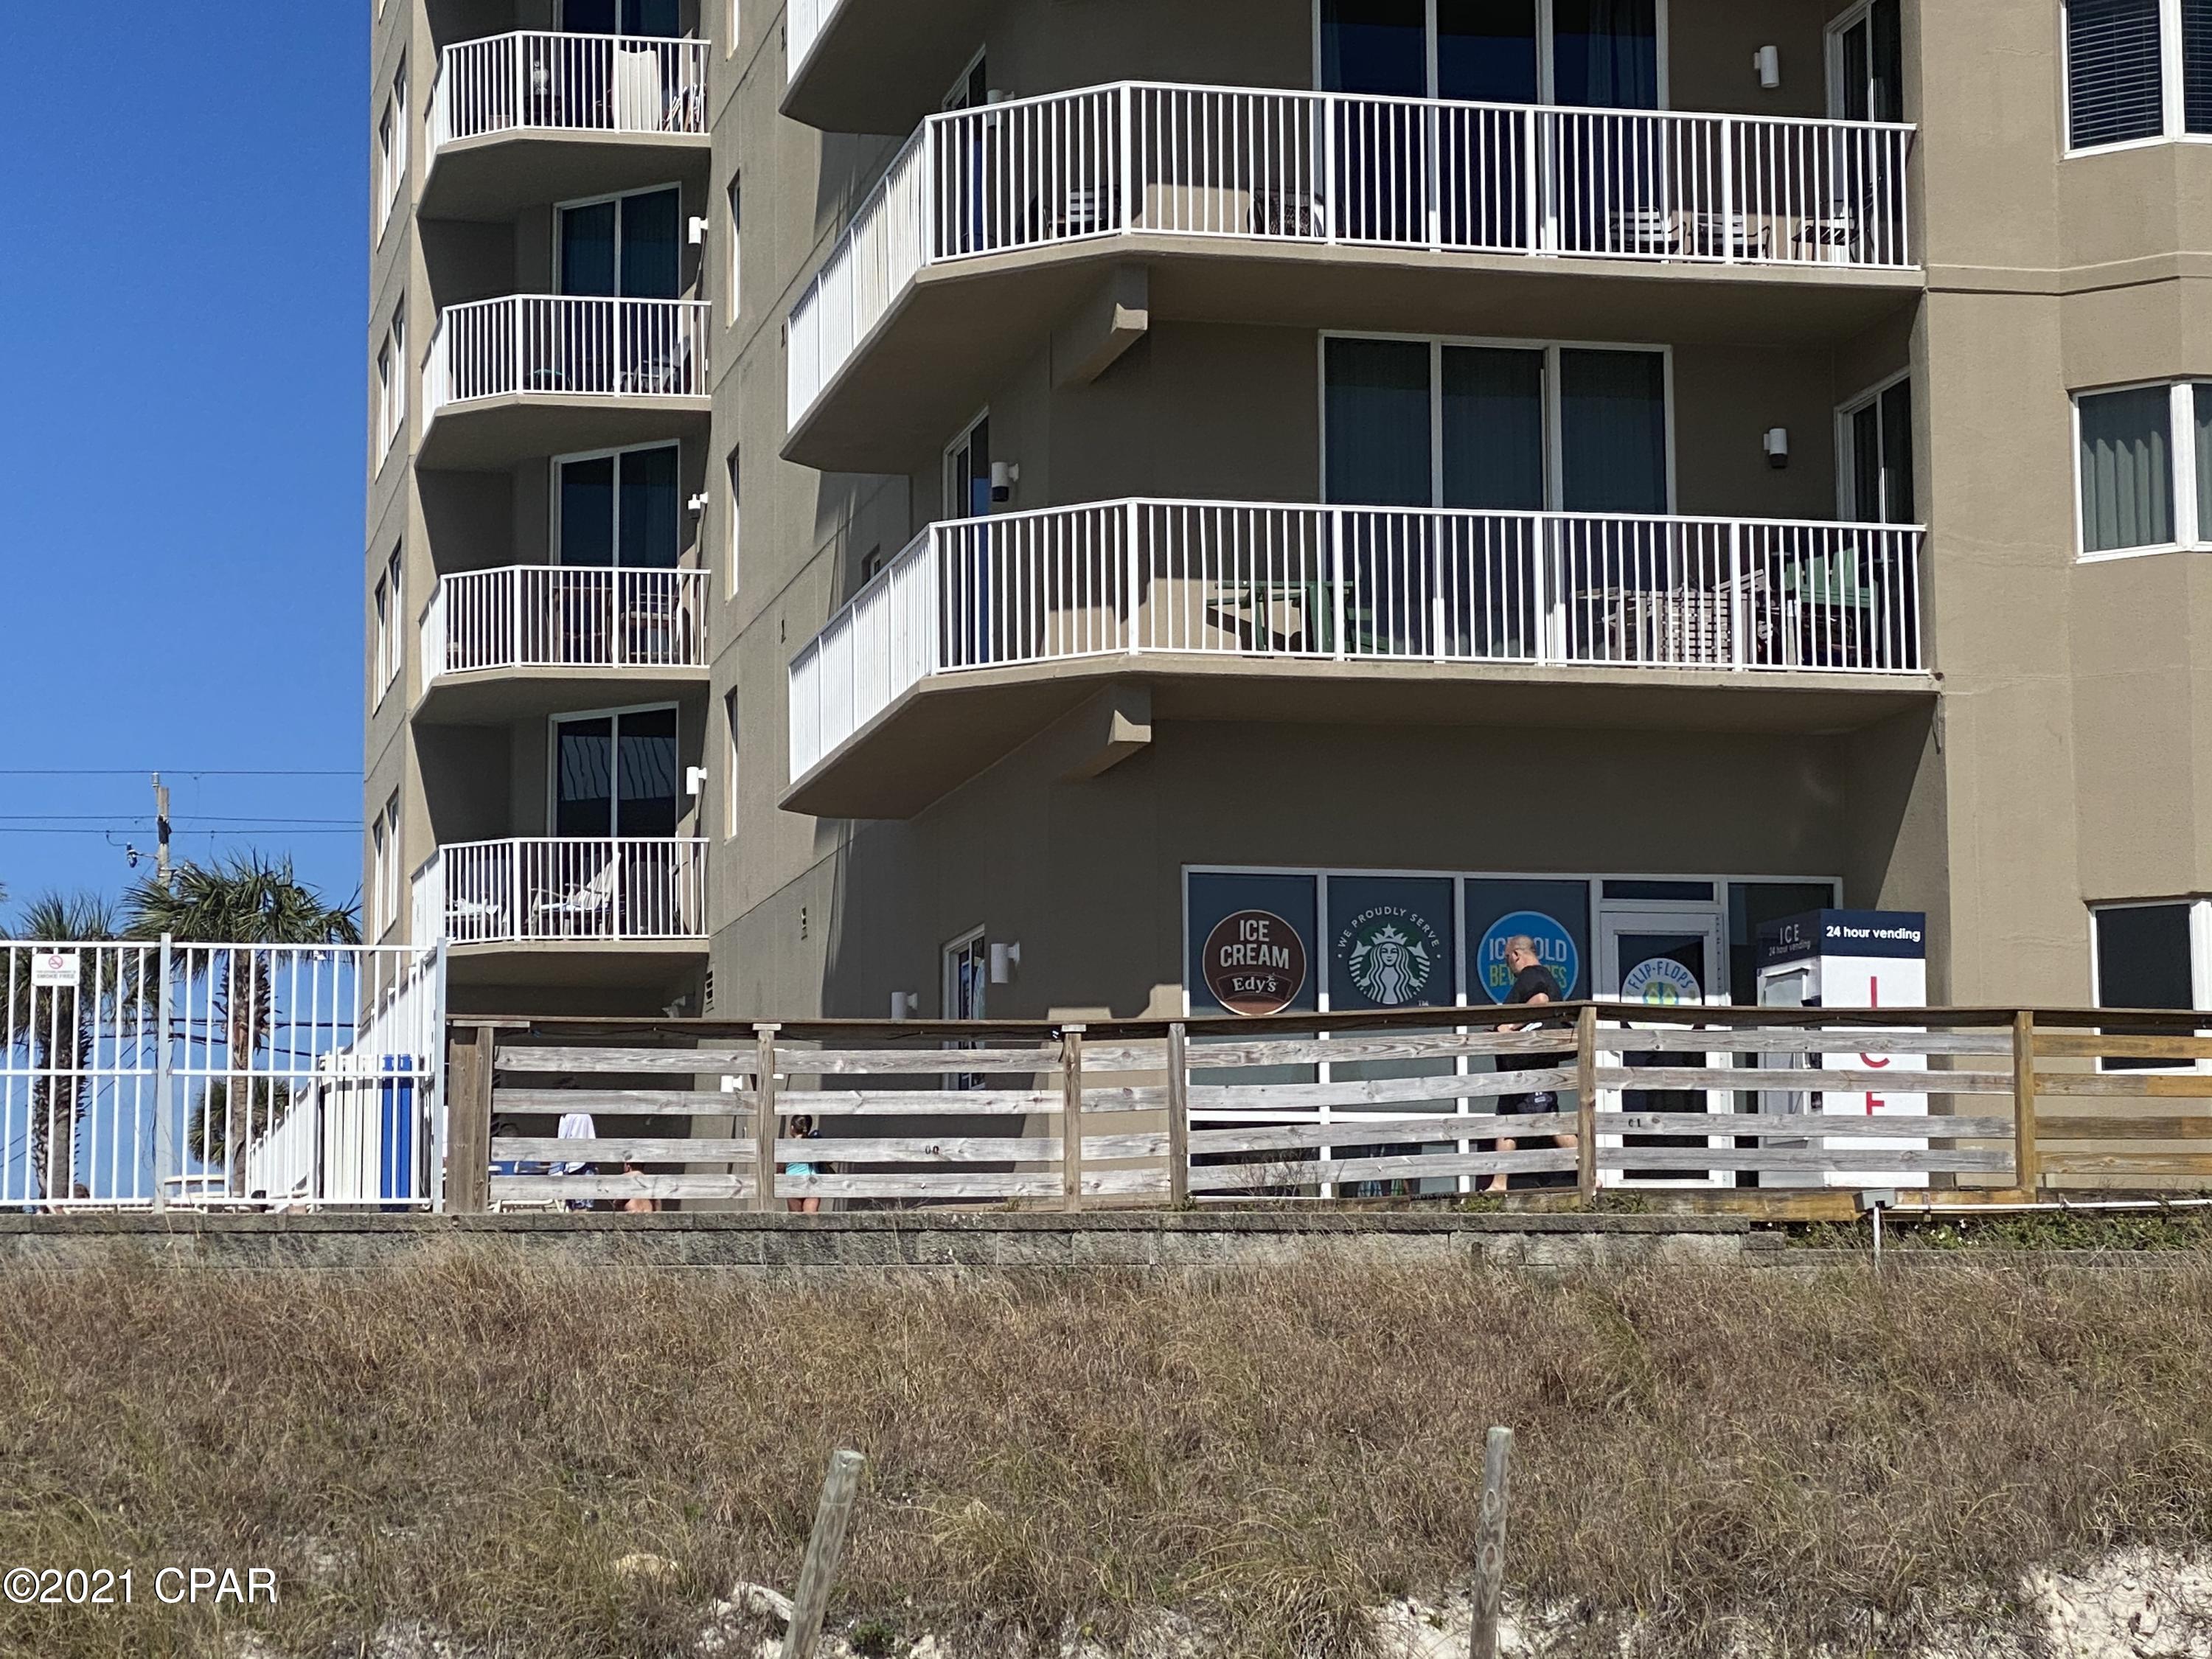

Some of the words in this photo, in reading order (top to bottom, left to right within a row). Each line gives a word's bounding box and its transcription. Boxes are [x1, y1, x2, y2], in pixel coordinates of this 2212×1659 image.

[1239, 919, 1270, 942] ICE
[1338, 929, 1352, 948] WE
[1351, 906, 1407, 928] PROUDLY
[1410, 914, 1440, 947] SERVE
[1780, 924, 1799, 945] ICE
[1826, 925, 1841, 937] 24
[1843, 926, 1871, 938] hour
[1873, 928, 1921, 942] vending
[1220, 944, 1289, 970] CREAM
[1489, 937, 1509, 961] IC
[1534, 937, 1567, 962] OLD
[1232, 975, 1277, 993] Edy's
[1628, 961, 1694, 990] FLIP-FLOPS
